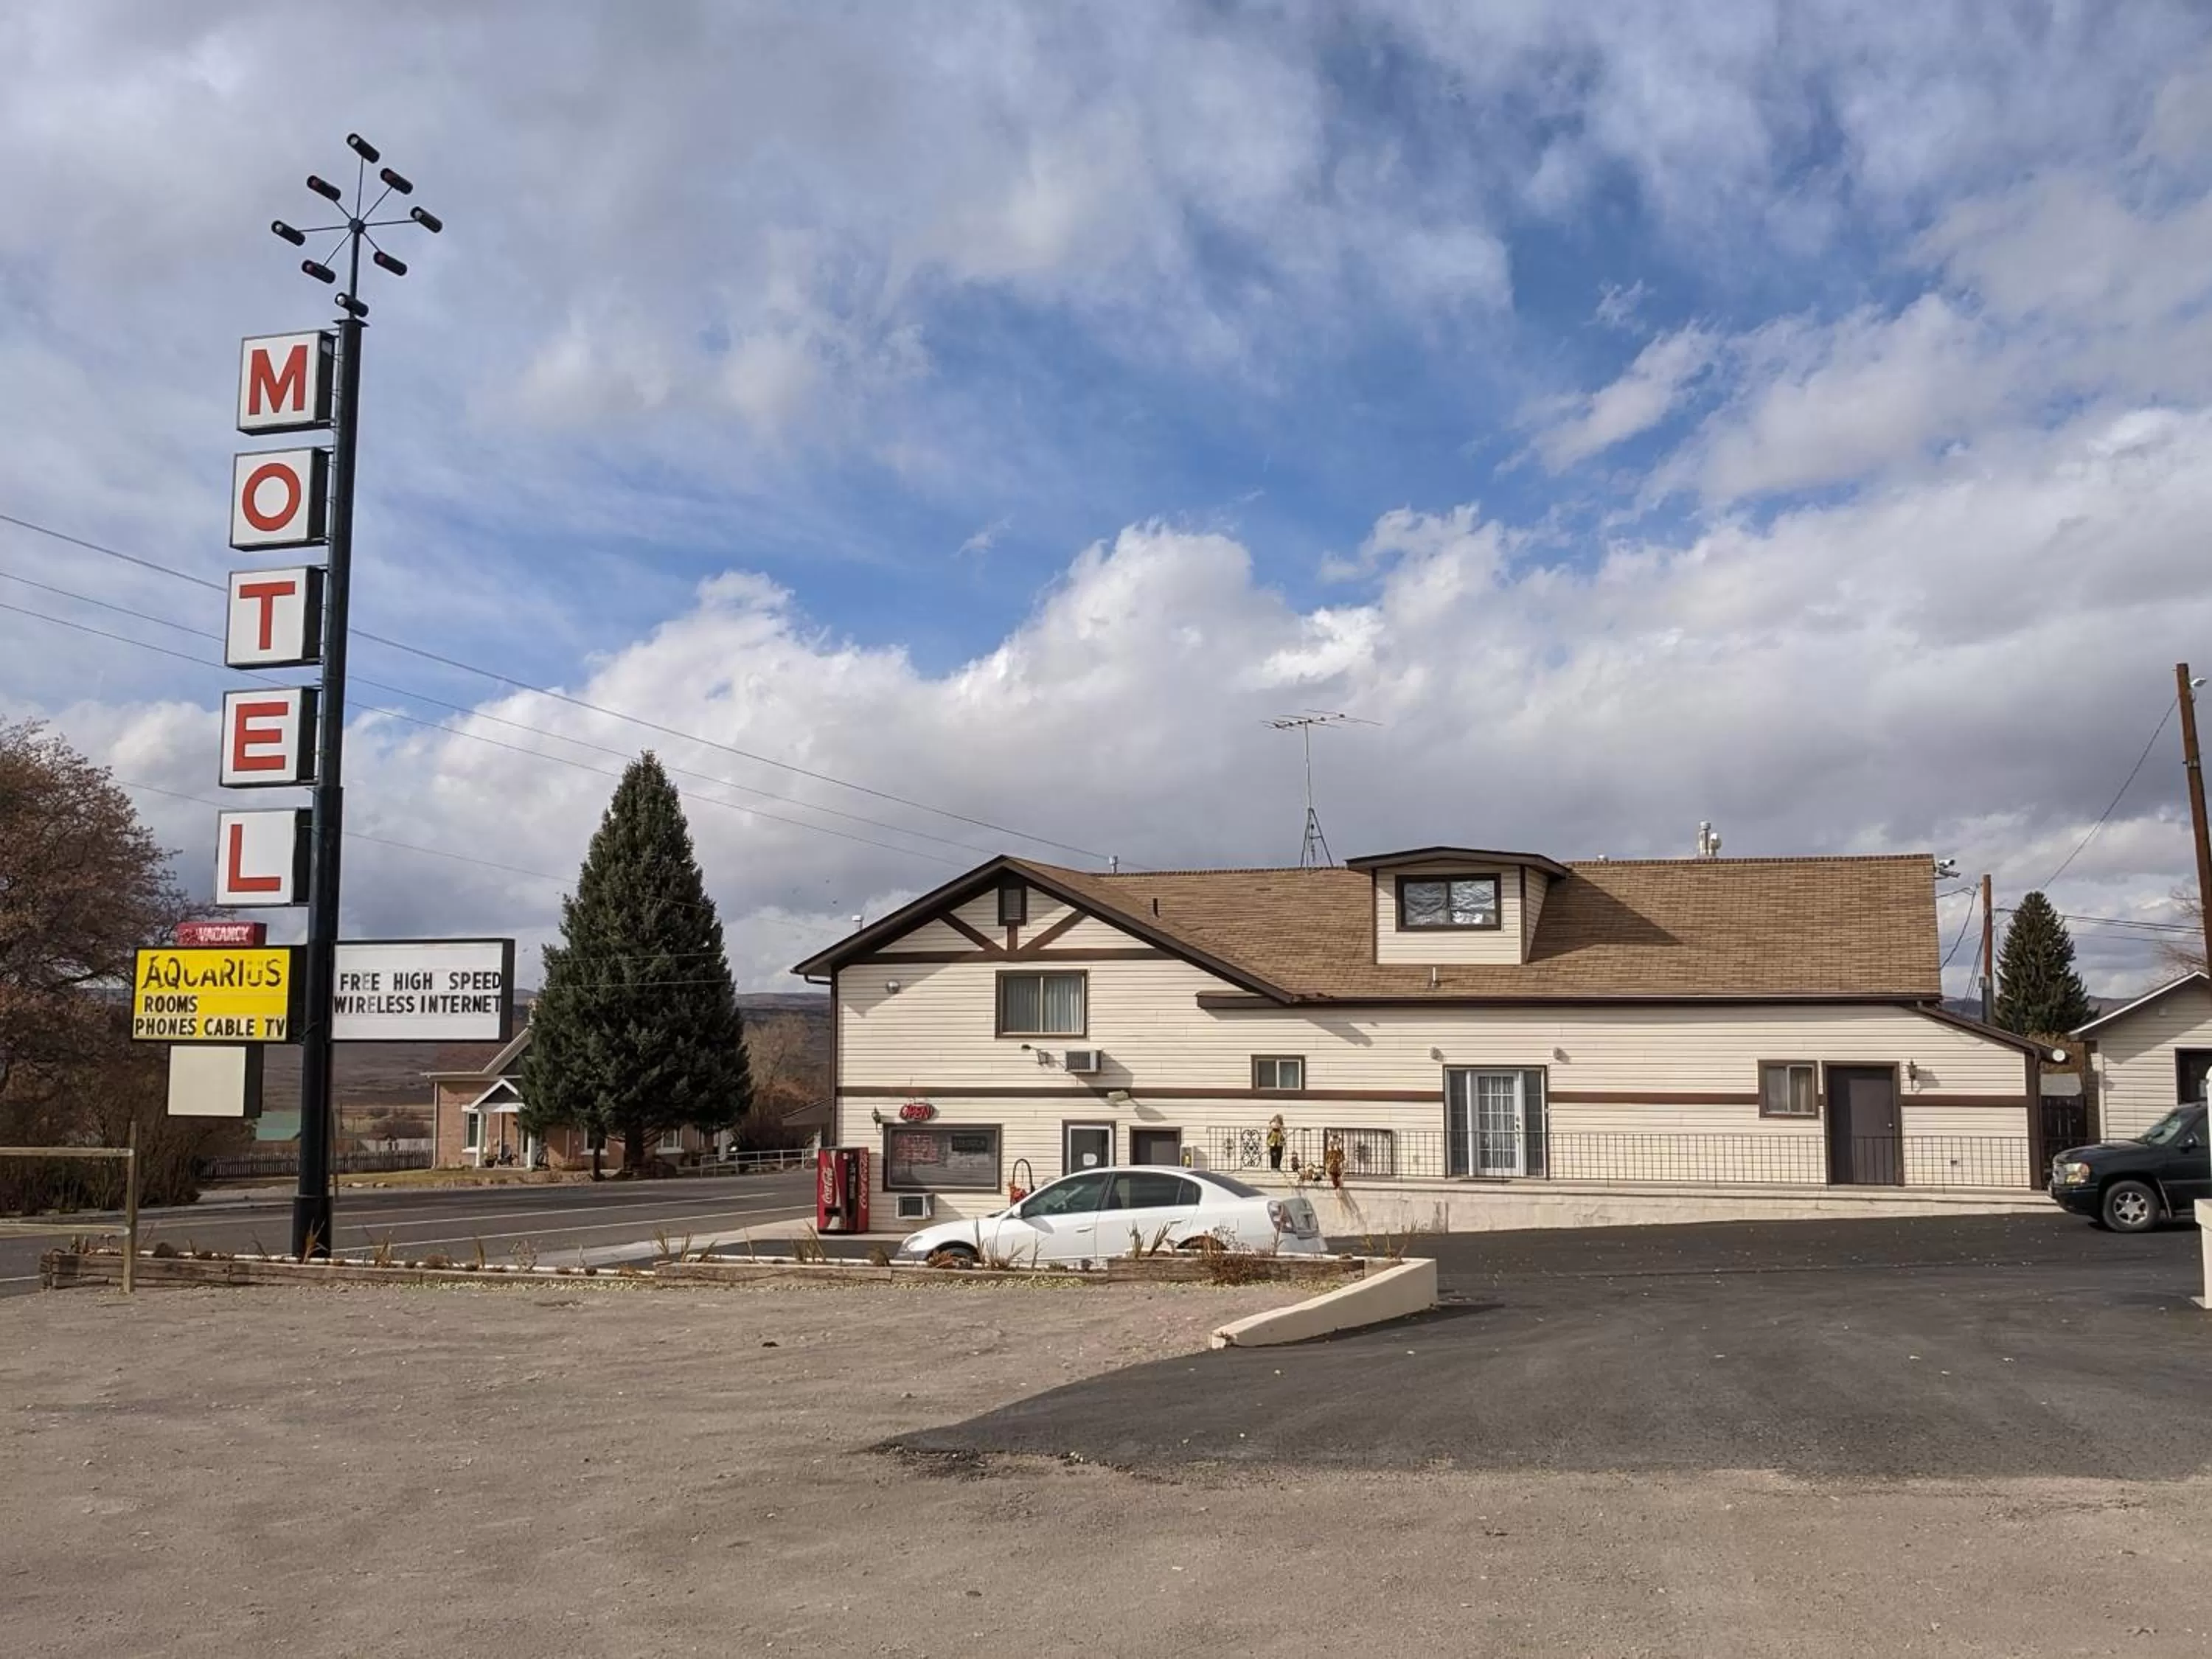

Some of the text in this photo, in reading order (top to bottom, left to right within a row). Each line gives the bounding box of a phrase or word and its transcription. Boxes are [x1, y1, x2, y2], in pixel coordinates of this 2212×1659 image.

[227, 344, 307, 893] MOTEL
[340, 971, 501, 991] FREE HIGH SPEED
[145, 995, 198, 1013] ROOMS
[334, 995, 501, 1014] WIRELESS INTERNET
[135, 1018, 285, 1036] PHONES CABLE TV
[902, 1104, 933, 1120] OPEN
